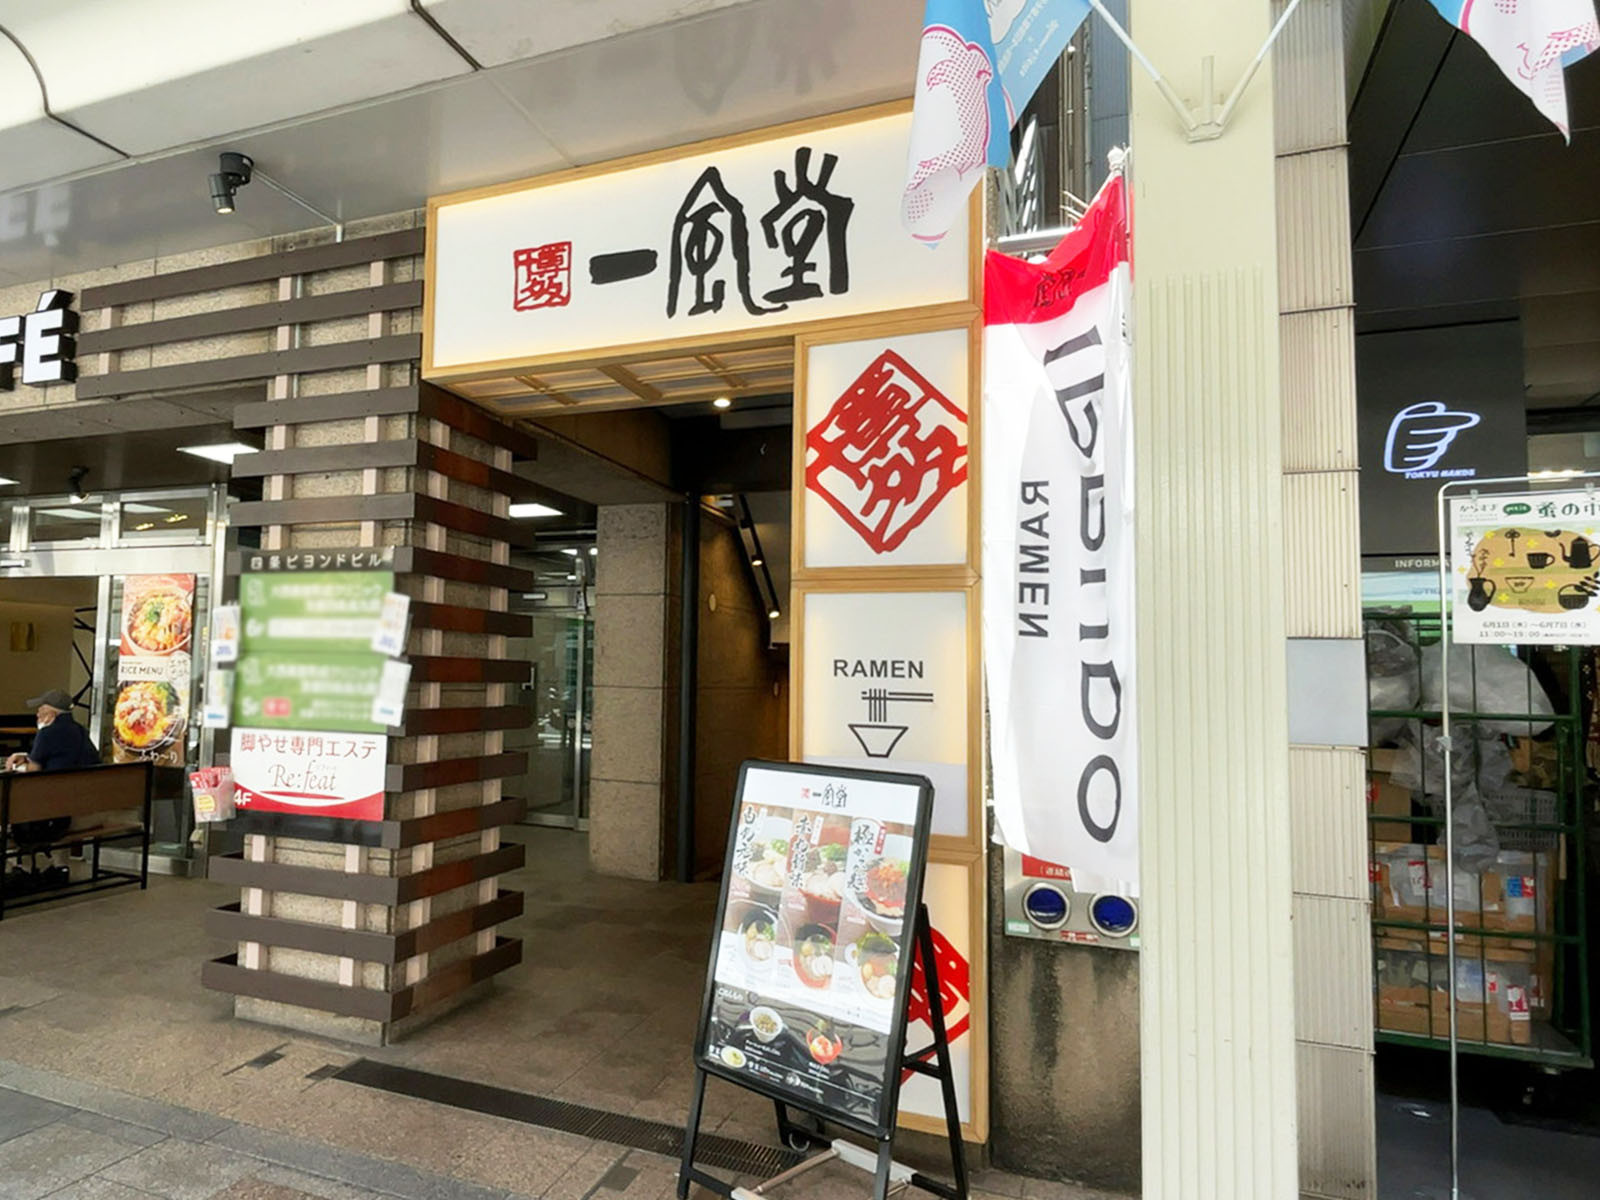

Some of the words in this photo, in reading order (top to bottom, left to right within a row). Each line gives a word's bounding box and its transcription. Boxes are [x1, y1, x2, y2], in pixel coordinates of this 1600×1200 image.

[589, 146, 855, 319] 一風堂
[1405, 470, 1439, 479] TOKYU
[833, 658, 925, 679] RAMEN
[267, 759, 337, 794] Re:feat
[233, 789, 253, 805] 4F
